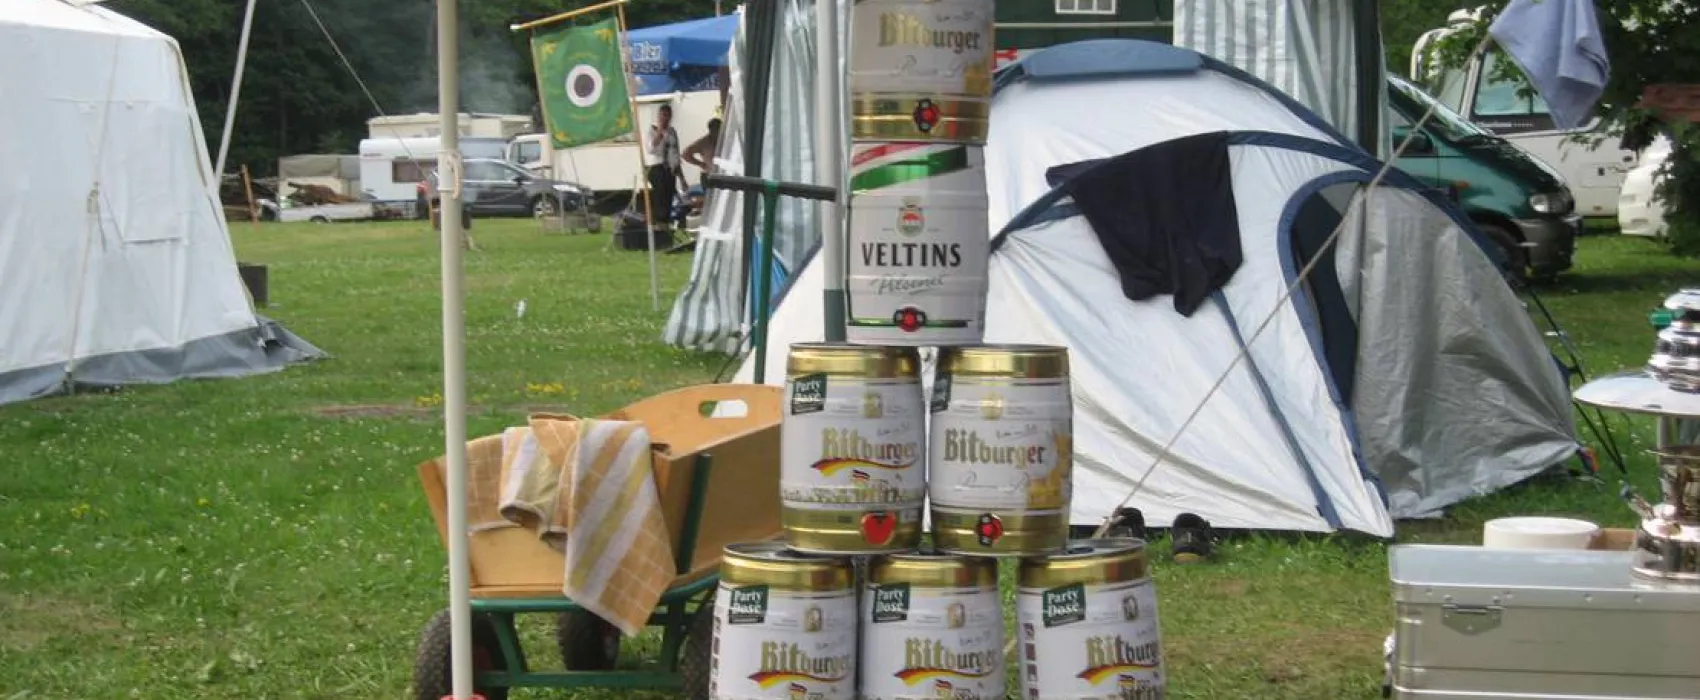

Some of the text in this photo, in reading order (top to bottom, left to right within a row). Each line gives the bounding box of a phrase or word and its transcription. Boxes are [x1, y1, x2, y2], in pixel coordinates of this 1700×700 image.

[861, 242, 962, 267] VELTINS
[943, 427, 1046, 471] Bitburger
[734, 590, 763, 603] Party
[877, 589, 905, 602] Party
[1046, 588, 1080, 604] Party
[731, 602, 762, 614] Dose
[875, 601, 905, 613] Dose
[1046, 600, 1081, 618] Dose
